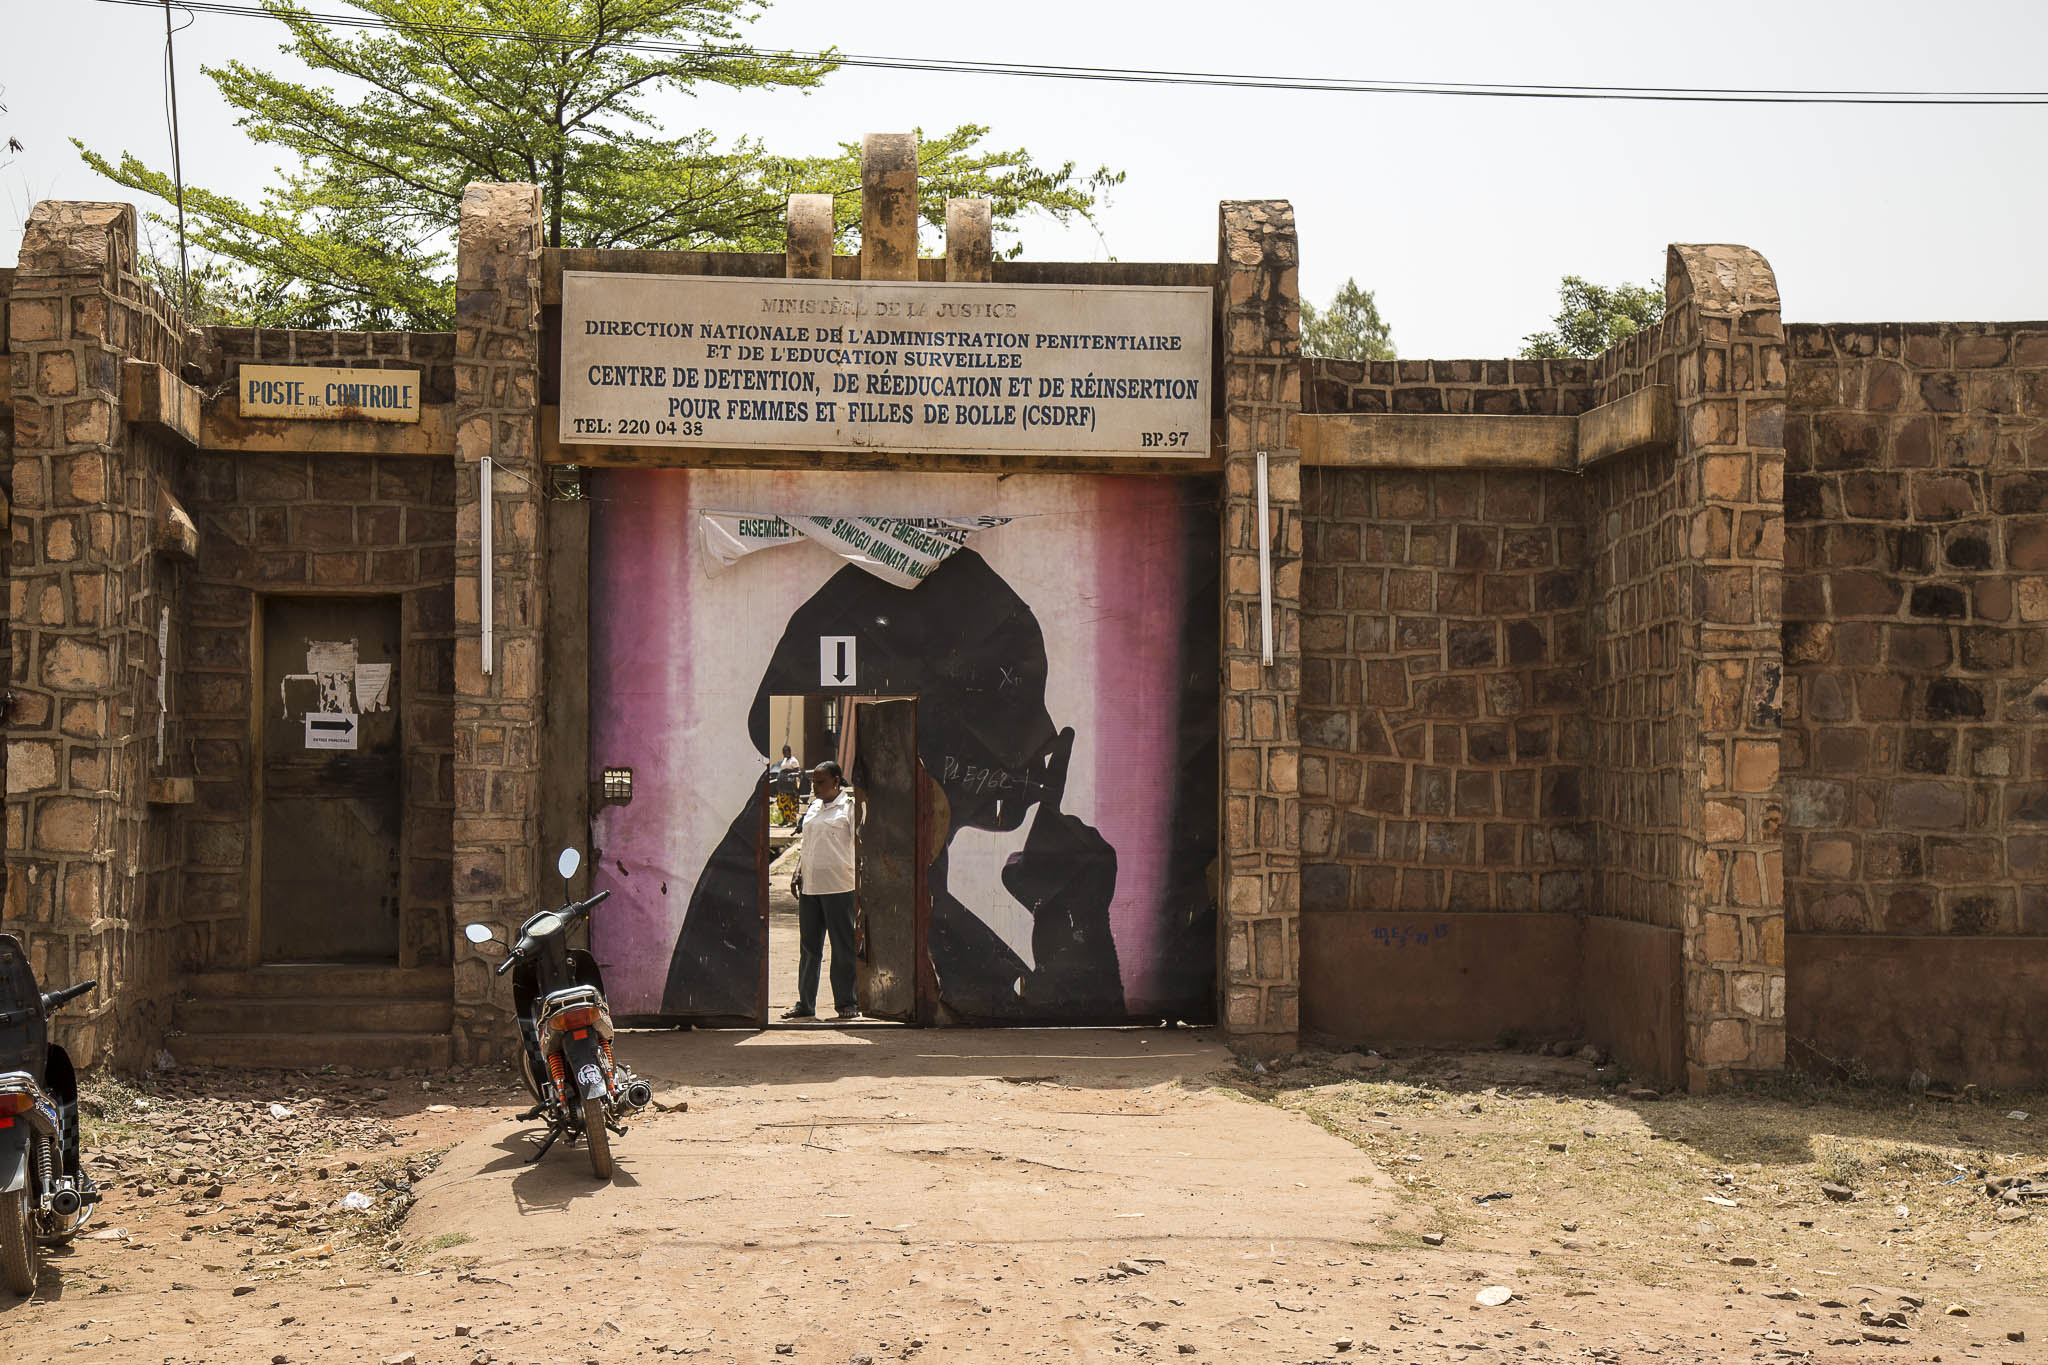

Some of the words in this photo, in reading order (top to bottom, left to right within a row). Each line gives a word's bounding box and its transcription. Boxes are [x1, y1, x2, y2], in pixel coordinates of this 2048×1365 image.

[936, 303, 1017, 319] JUSTICE
[585, 320, 693, 338] DIRECTION
[699, 324, 810, 342] NATIONALE
[815, 327, 842, 344] DE
[848, 329, 1030, 348] L'ADMINISTRATION
[1035, 334, 1182, 351] PENITENTIAIRE
[706, 344, 732, 360] ET
[737, 345, 765, 361] DE
[770, 346, 898, 366] L'EDUCATION
[904, 351, 1023, 369] SURVEILLEE
[249, 380, 305, 406] POSTE
[308, 395, 321, 407] DE
[324, 382, 412, 409] CONTROLE
[588, 364, 667, 387] CENTRE
[672, 367, 699, 388] DE
[704, 368, 820, 396] DETENTION,
[832, 372, 860, 394] DE
[866, 369, 1002, 397] RÉEDUCATION
[1007, 376, 1033, 398] ET
[1038, 377, 1065, 399] DE
[1070, 372, 1200, 400] RÉINSERTION
[574, 418, 612, 434] TEL:
[618, 419, 650, 435] 220
[655, 420, 677, 435] 04
[682, 421, 703, 437] 38
[668, 397, 721, 420] POUR
[726, 400, 809, 423] FEMMES
[815, 401, 837, 423] ET
[847, 402, 914, 424] FILLES
[923, 403, 950, 425] DE
[955, 404, 1017, 426] BOLLE
[1022, 404, 1097, 433] (CSDRF)
[1141, 431, 1190, 447] BP.97
[739, 519, 790, 538] ENSEMBLE
[891, 520, 951, 560] EMERGEANT
[831, 518, 872, 551] SANOGO
[866, 539, 910, 573] AMINATA
